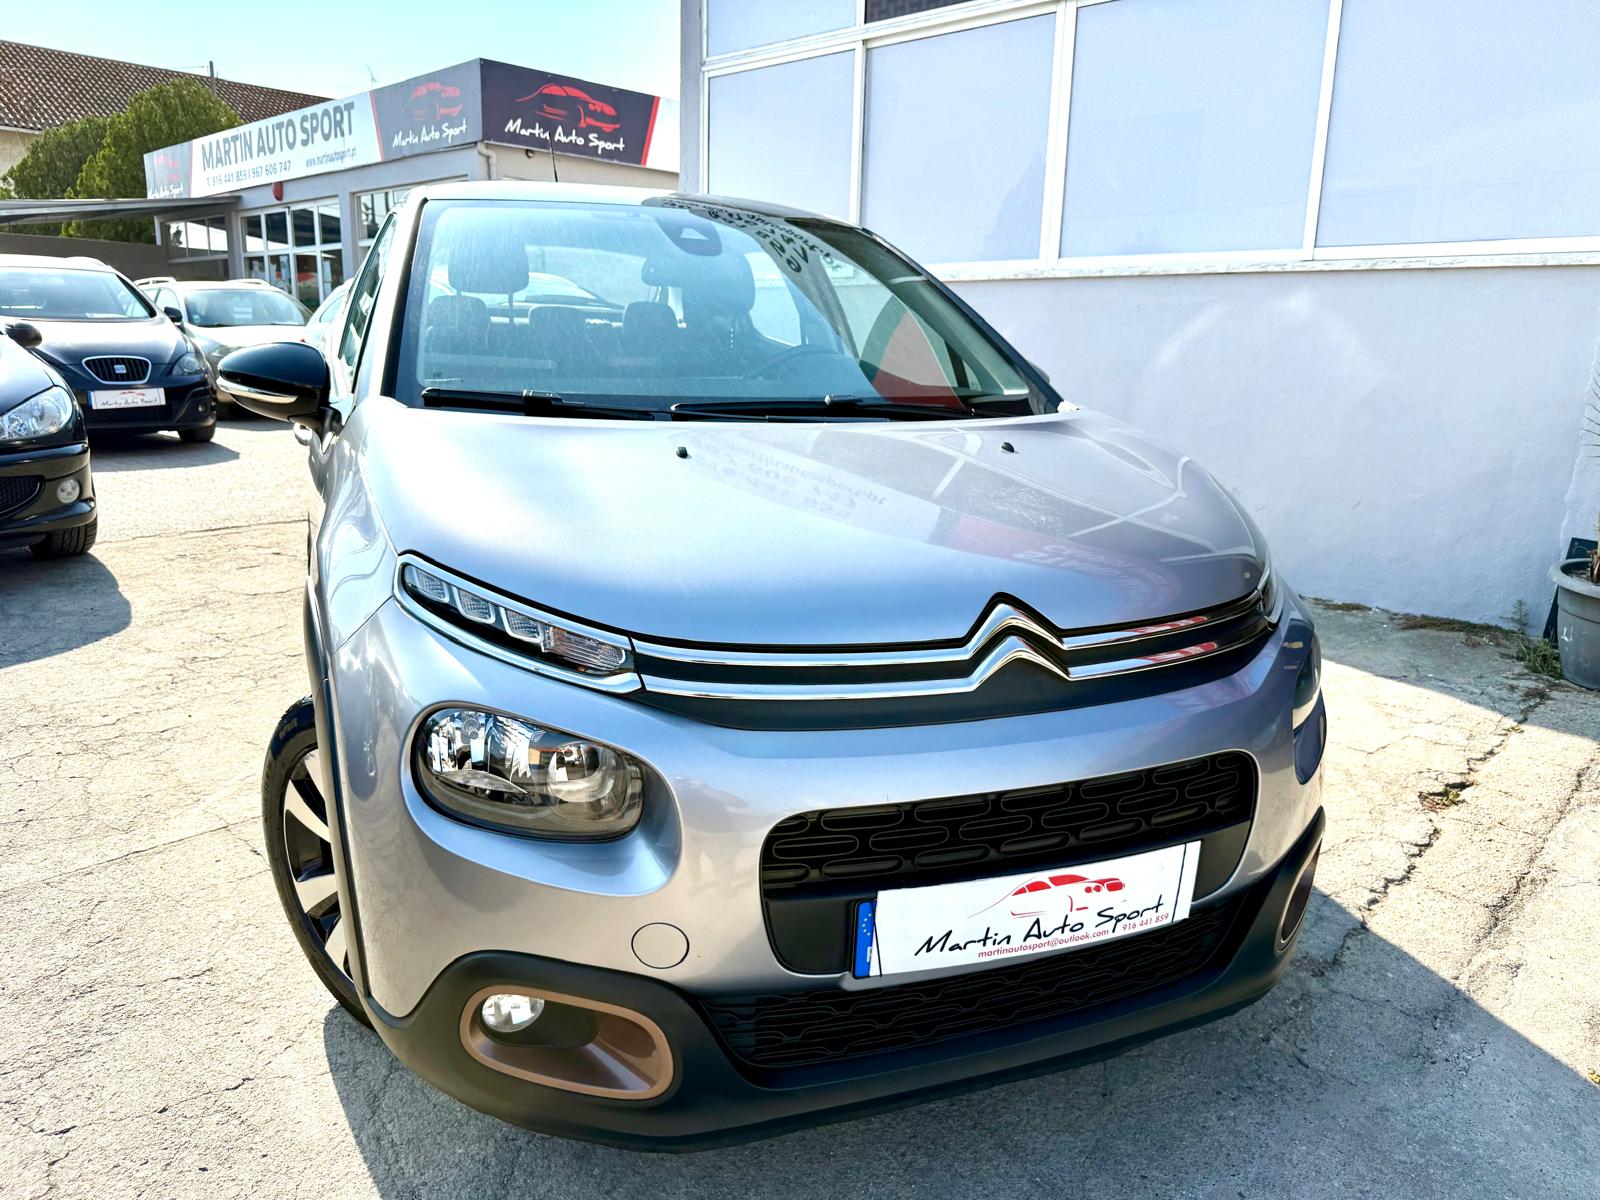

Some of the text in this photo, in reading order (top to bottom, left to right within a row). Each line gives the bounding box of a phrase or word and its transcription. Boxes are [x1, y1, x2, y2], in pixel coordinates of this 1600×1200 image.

[201, 101, 355, 172] MARTIN AUTO SPORT
[392, 118, 467, 147] Martin Auto Sport
[504, 118, 625, 154] Martin Auto Sport
[251, 166, 263, 179] 967
[265, 163, 278, 176] 606
[278, 160, 292, 173] 747
[914, 894, 1164, 956] Martin Auto Sport
[978, 913, 1170, 958] martinautosport@outlook.com 916 441 859
